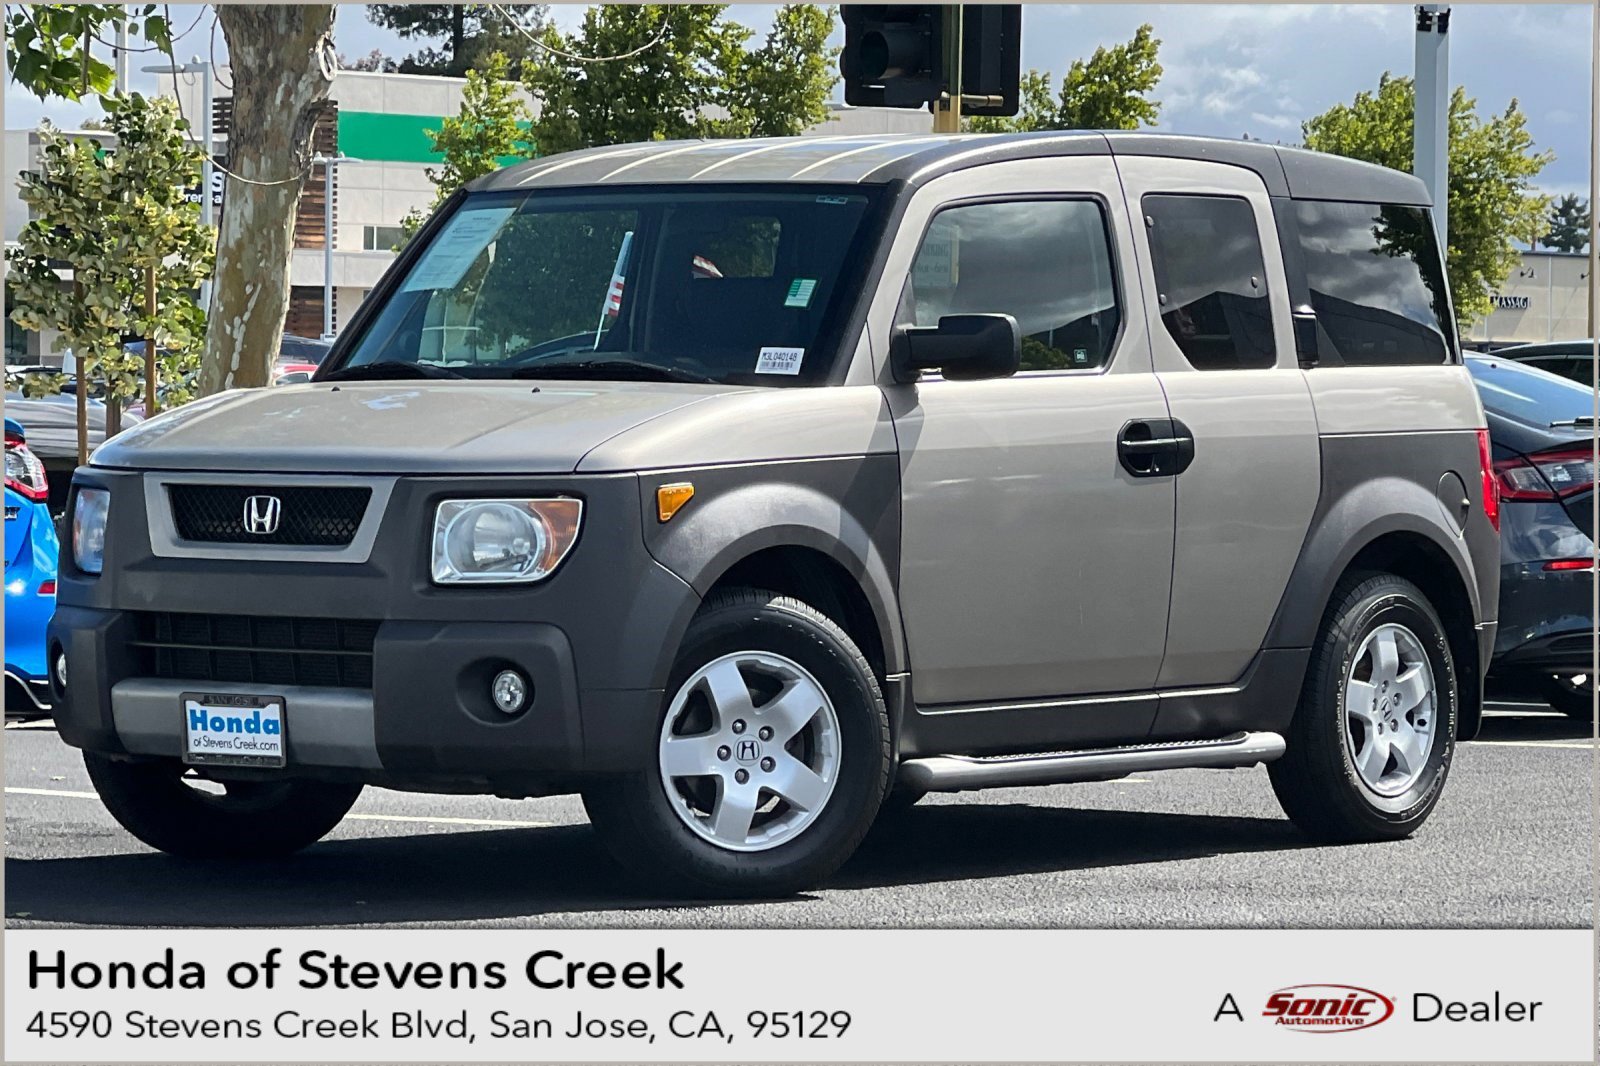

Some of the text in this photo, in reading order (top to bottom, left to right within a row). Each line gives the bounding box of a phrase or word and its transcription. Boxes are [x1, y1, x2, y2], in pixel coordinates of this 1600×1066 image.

[189, 709, 280, 735] Honda
[193, 735, 279, 752] of Stevens Creek.com
